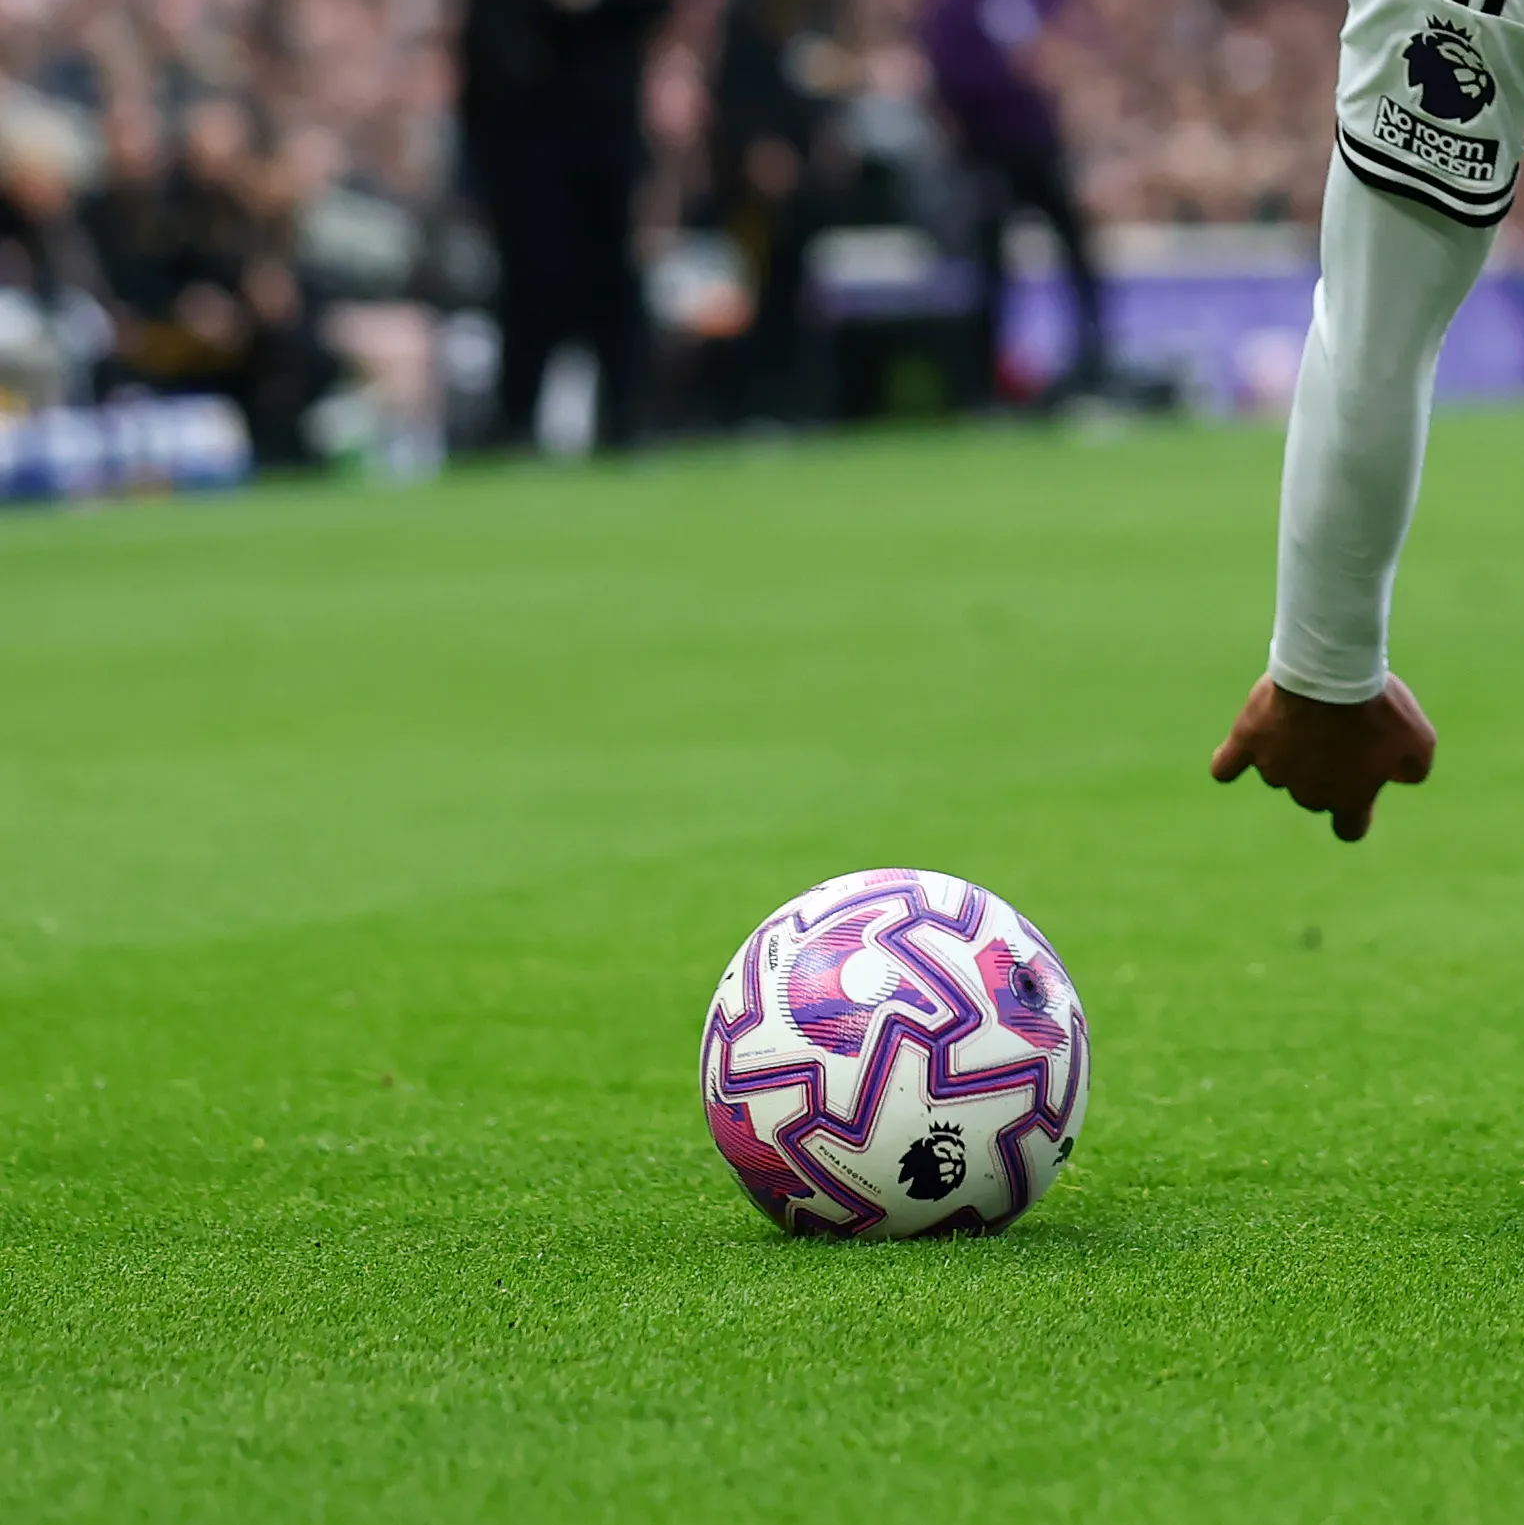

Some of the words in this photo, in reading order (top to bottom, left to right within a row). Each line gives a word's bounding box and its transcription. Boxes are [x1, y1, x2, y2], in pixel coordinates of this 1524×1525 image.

[1379, 97, 1412, 131] No
[1415, 122, 1484, 161] room
[1412, 138, 1493, 180] racism
